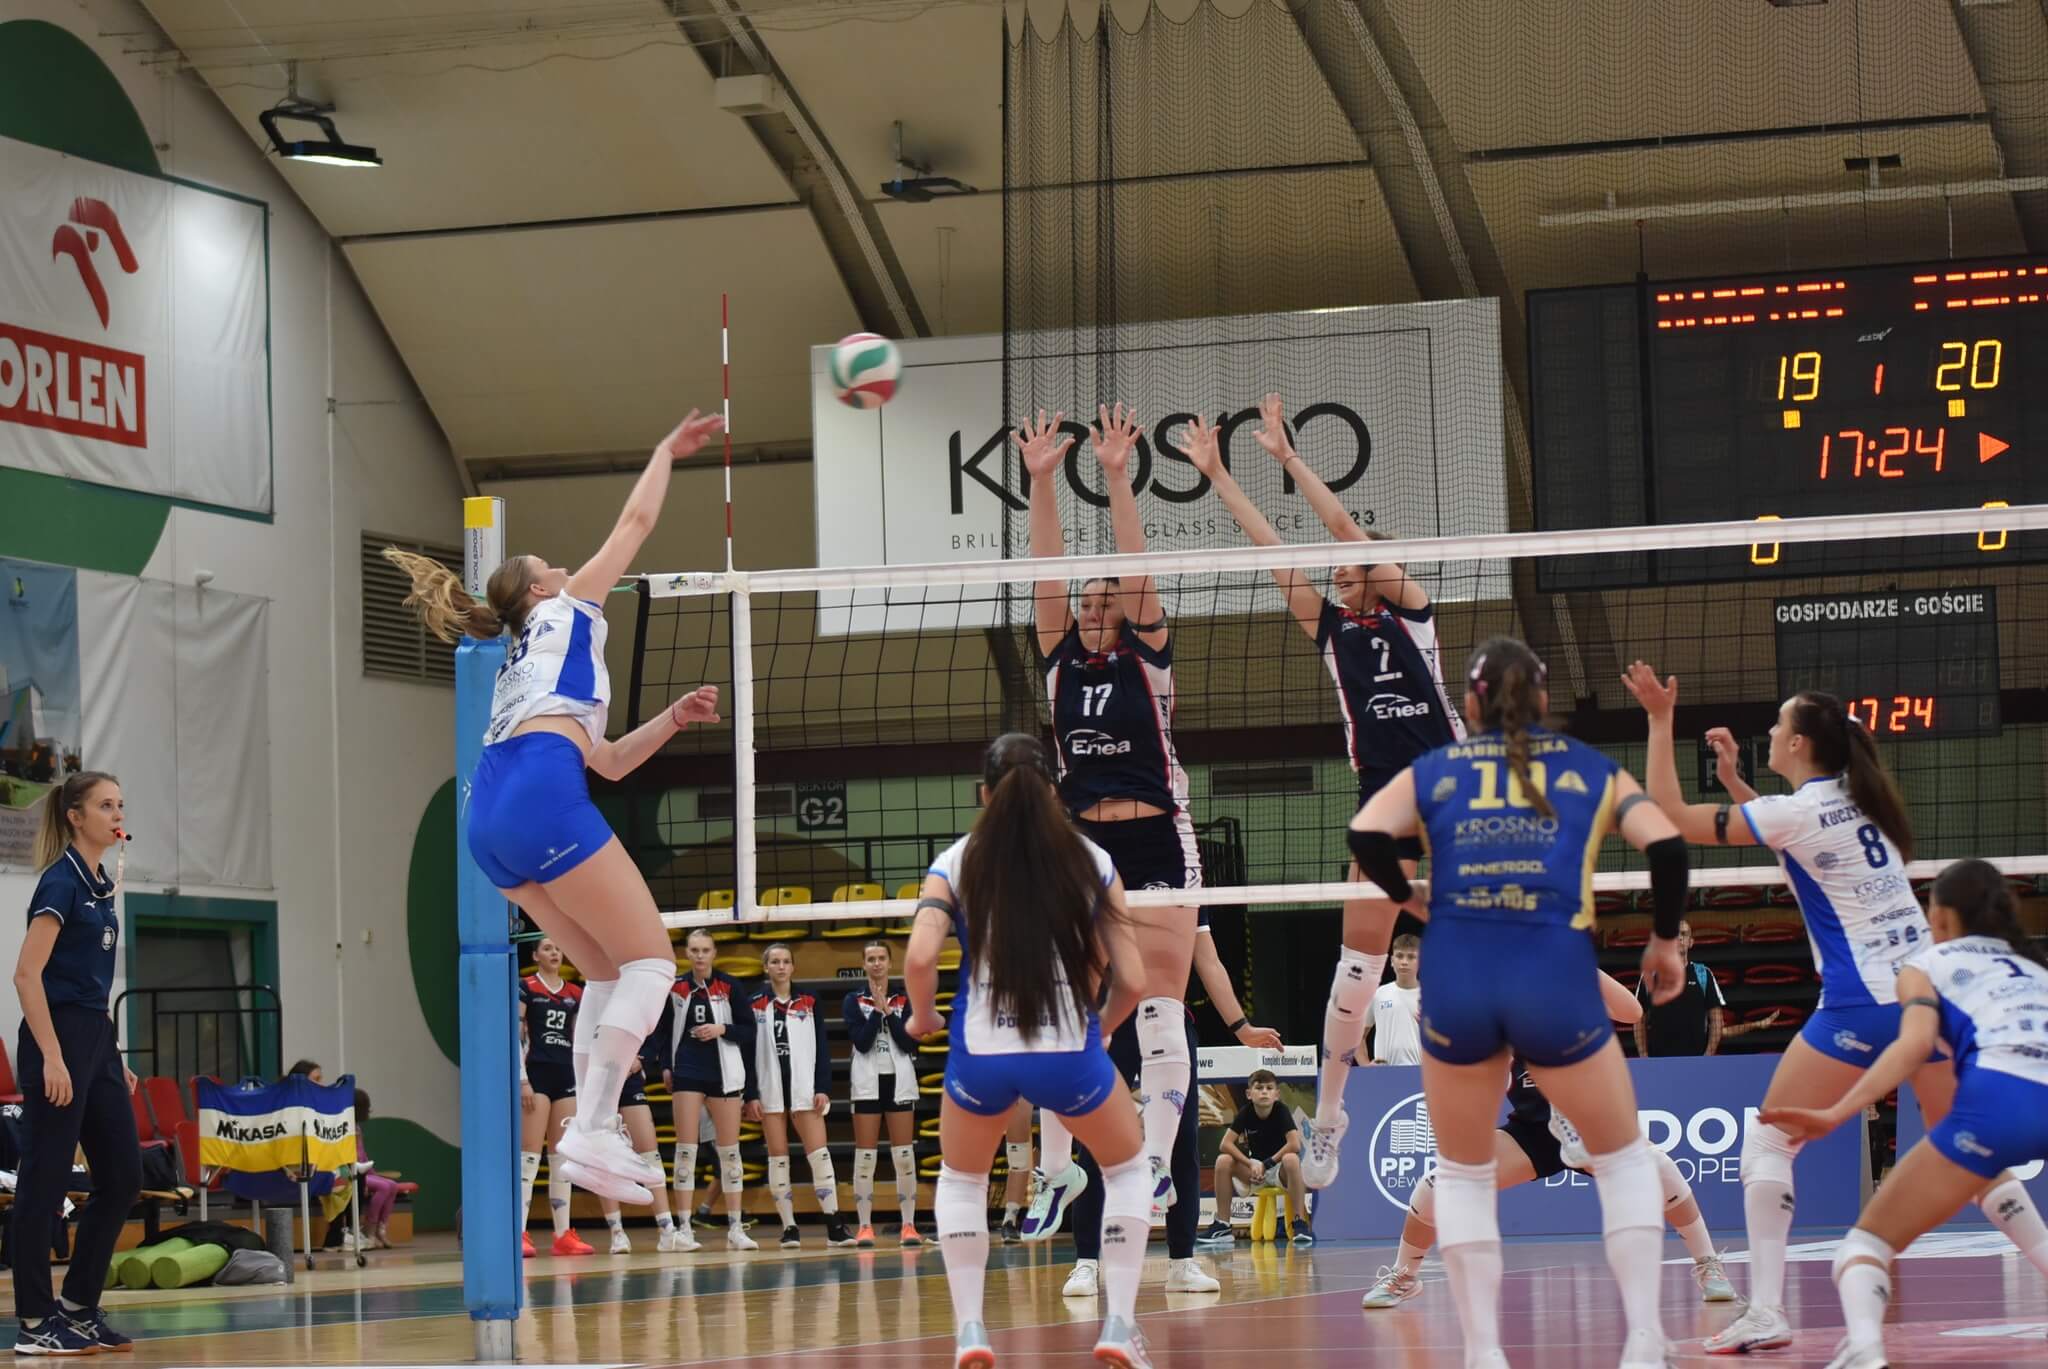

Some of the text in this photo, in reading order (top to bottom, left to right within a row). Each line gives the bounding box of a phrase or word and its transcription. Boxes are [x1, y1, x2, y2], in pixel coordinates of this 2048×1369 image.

[1777, 352, 1821, 401] 19
[1874, 363, 1884, 395] 1
[1936, 339, 2002, 391] 20
[0, 337, 138, 432] ORLEN
[1819, 427, 1945, 479] 17:24
[1144, 519, 1216, 539] GLASS
[1232, 513, 1304, 534] SCE
[1776, 598, 1899, 623] GOSPODARZE
[1914, 592, 1984, 616] GOŚCIE
[1371, 636, 1403, 683] 2
[1081, 683, 1113, 717] 17
[1372, 702, 1430, 719] Enea
[1889, 696, 1933, 731] 24
[1071, 739, 1131, 756] Enea
[1468, 760, 1547, 811] 10
[800, 797, 845, 826] G2
[1456, 815, 1560, 835] KROSNO
[1856, 823, 1890, 870] 8
[545, 1009, 567, 1030] 23
[694, 1004, 706, 1023] 8
[1381, 1156, 1416, 1177] PP
